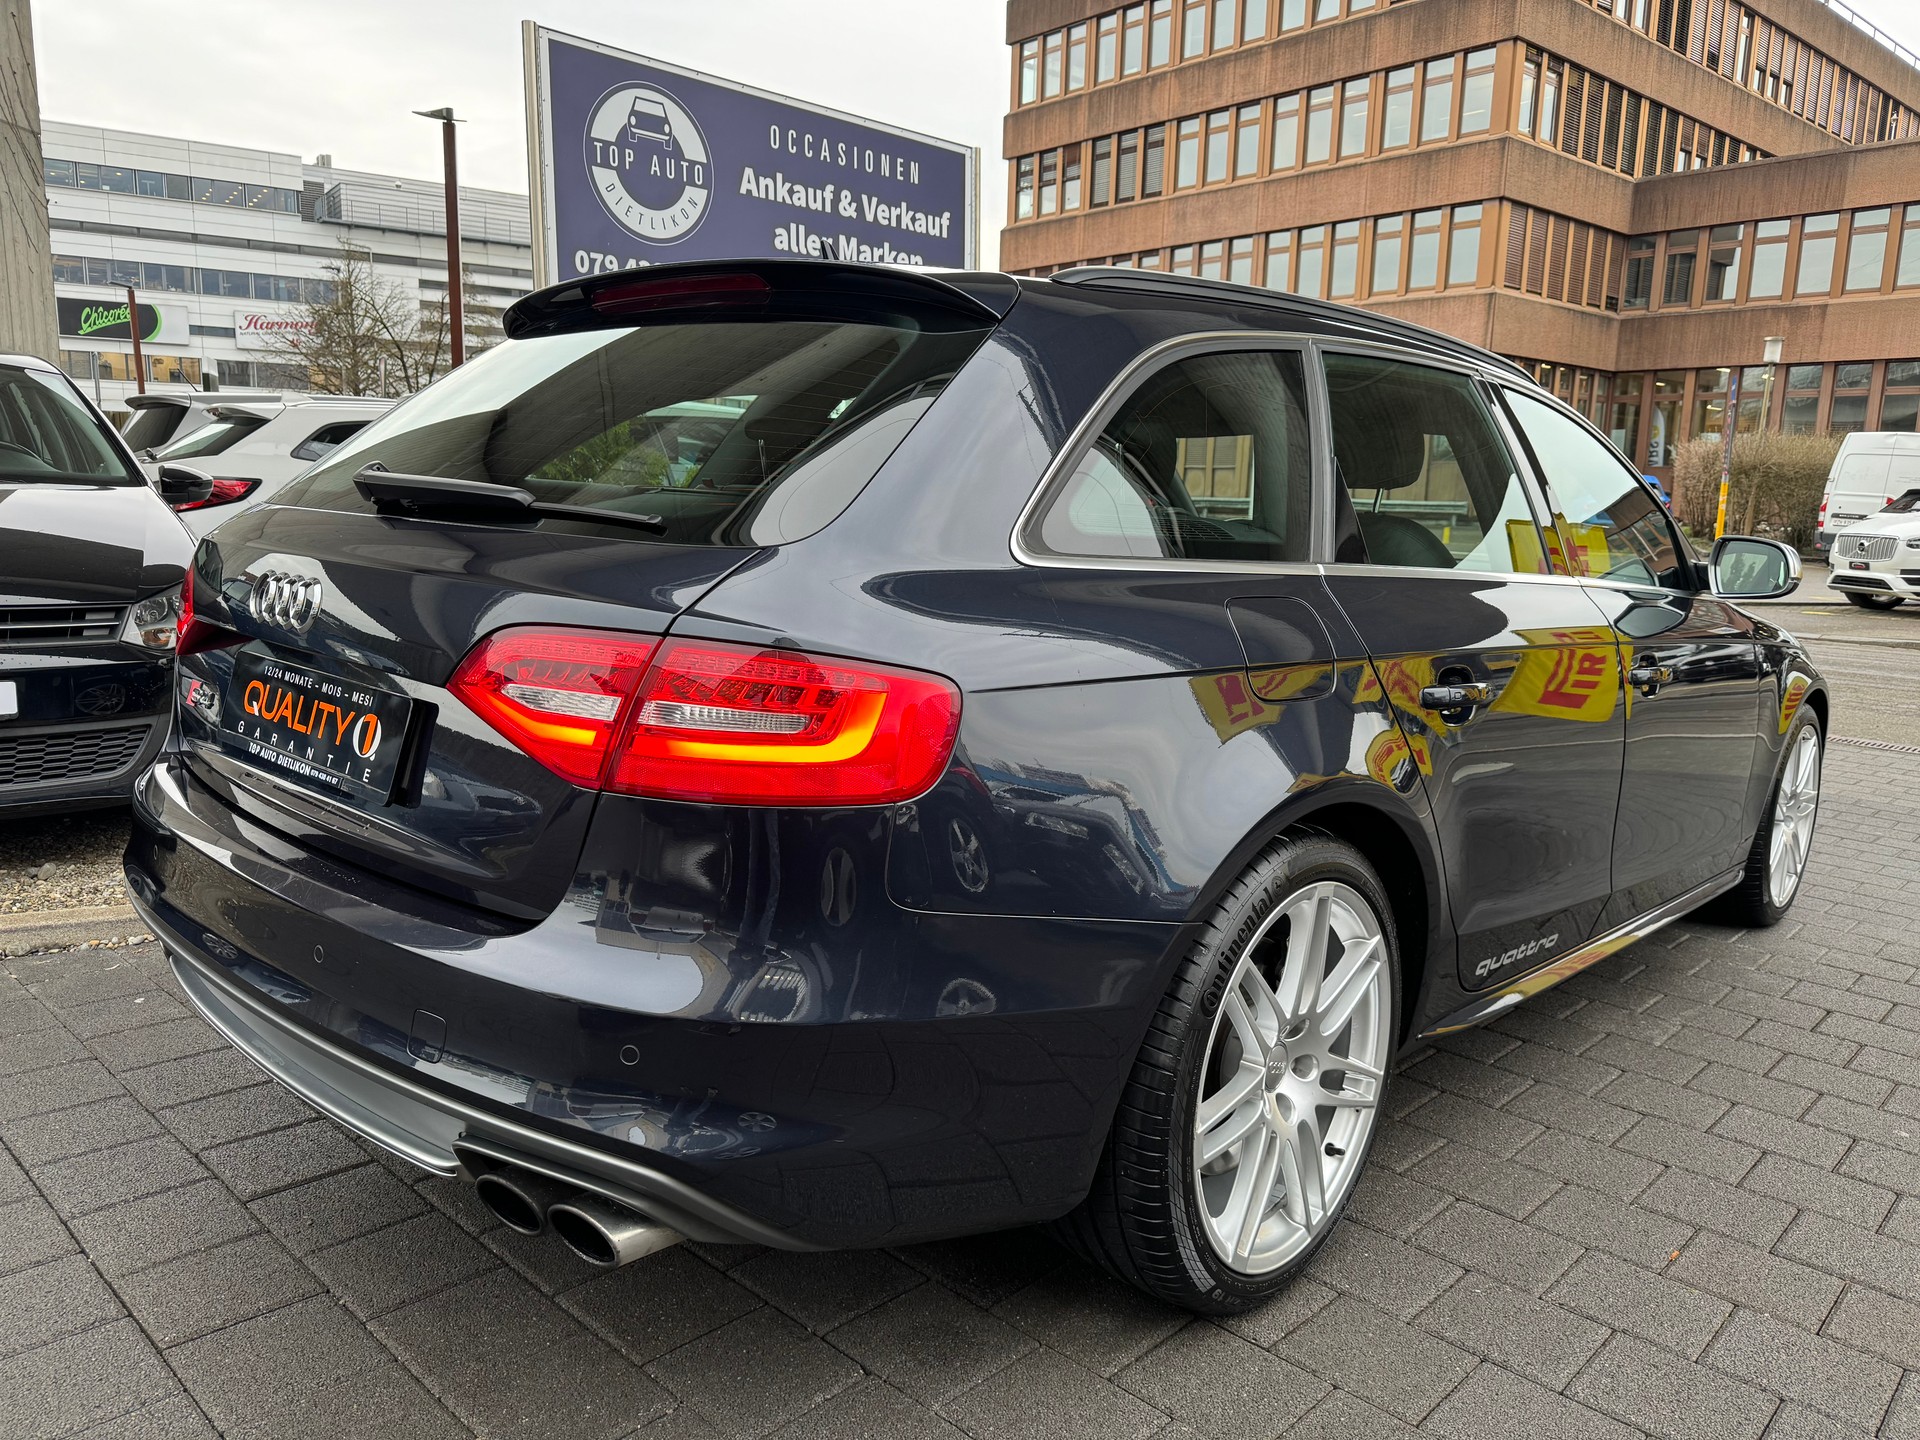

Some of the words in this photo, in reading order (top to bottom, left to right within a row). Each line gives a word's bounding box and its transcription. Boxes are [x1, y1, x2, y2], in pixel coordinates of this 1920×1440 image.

[594, 141, 634, 170] TOP
[650, 154, 703, 185] AUTO
[770, 125, 919, 184] OCCASIONEN
[605, 183, 698, 230] DIETLIKON
[739, 167, 835, 213] Ankauf
[838, 189, 857, 219] &
[861, 194, 950, 238] Verkauf
[575, 250, 619, 274] 079
[264, 666, 282, 678] 12/24
[284, 671, 313, 688] MONATE
[321, 682, 342, 697] MOIS
[352, 691, 373, 706] MESI
[244, 680, 355, 746] QUALITY
[238, 721, 371, 782] GARANTIE
[248, 742, 260, 755] TOP
[260, 748, 277, 761] AUTO
[277, 755, 311, 776] DIETLIKON
[1200, 887, 1274, 1019] Continental
[1475, 933, 1559, 976] quattro
